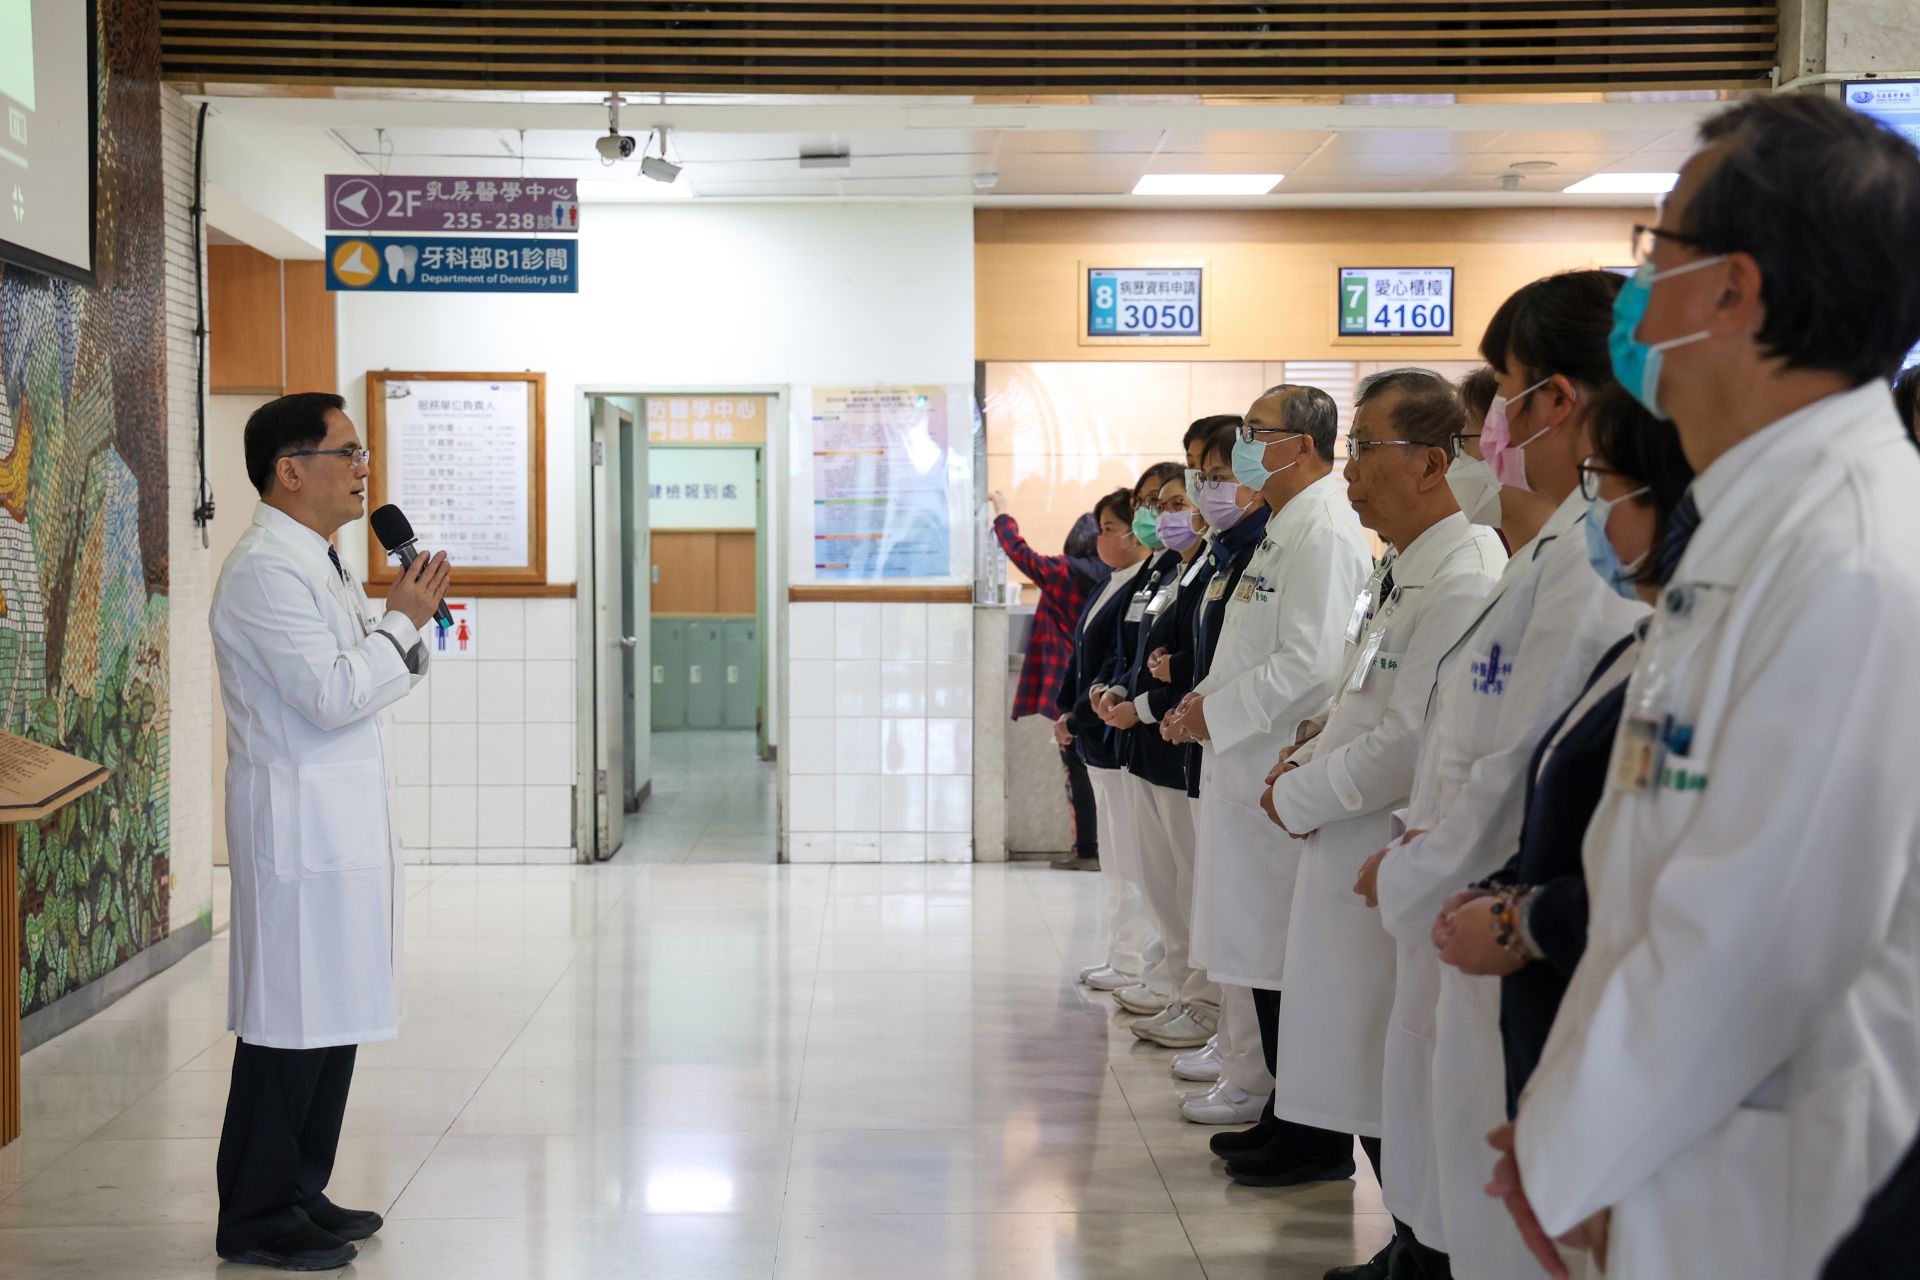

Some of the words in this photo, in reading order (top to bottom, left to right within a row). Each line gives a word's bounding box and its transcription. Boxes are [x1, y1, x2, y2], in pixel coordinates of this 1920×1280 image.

[426, 181, 573, 202] 乳房醫學中心
[387, 190, 422, 218] 2F
[421, 247, 568, 271] 牙科部B1診間
[421, 273, 485, 285] Department
[487, 273, 499, 284] of
[500, 274, 548, 286] Dentistry
[550, 275, 570, 285] B1F
[1096, 285, 1114, 310] 8
[1346, 285, 1365, 309] 7
[1124, 304, 1195, 329] 3050
[1373, 304, 1446, 328] 4160
